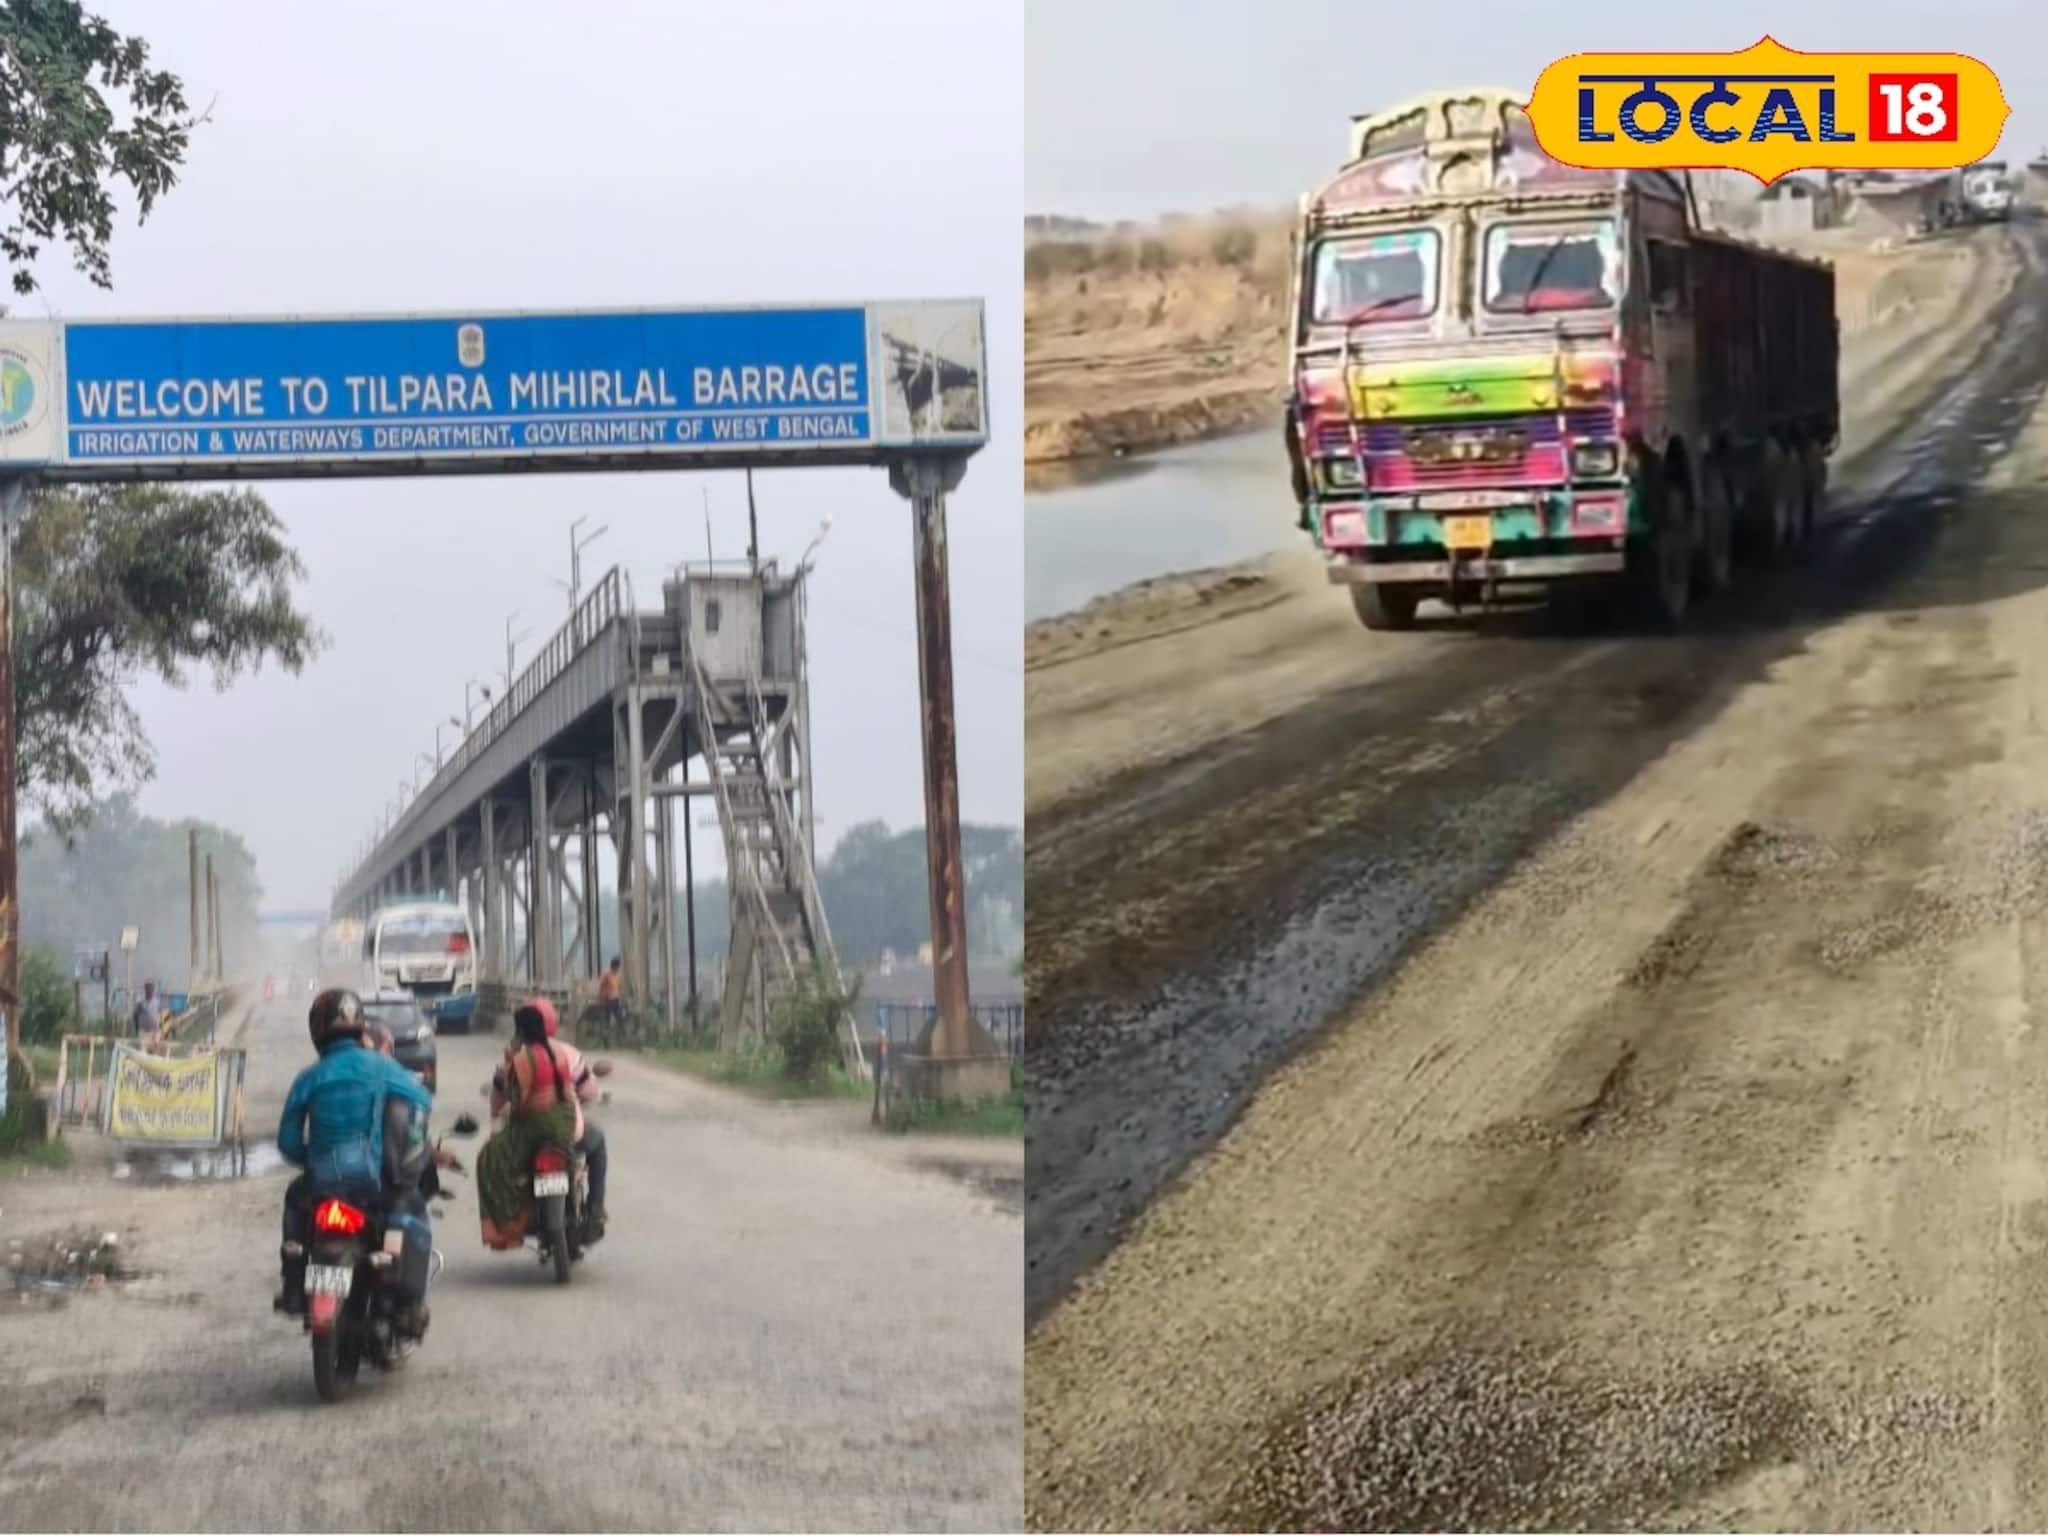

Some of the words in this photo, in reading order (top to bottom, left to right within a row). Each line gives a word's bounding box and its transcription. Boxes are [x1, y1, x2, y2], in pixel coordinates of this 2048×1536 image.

[77, 378, 265, 418] WELCOME
[281, 378, 328, 415] TO
[345, 374, 493, 413] TILPARA
[510, 367, 678, 410] MIHIRLAL
[693, 364, 859, 404] BARRAGE
[78, 431, 199, 454] IRRIGATION
[210, 430, 224, 450] &
[233, 429, 363, 450] WATERWAYS
[373, 424, 515, 449] DEPARTMENT,
[524, 420, 666, 444] GOVERNMENT
[676, 419, 702, 438] OF
[711, 415, 770, 438] WEST
[778, 414, 859, 436] BENGAL
